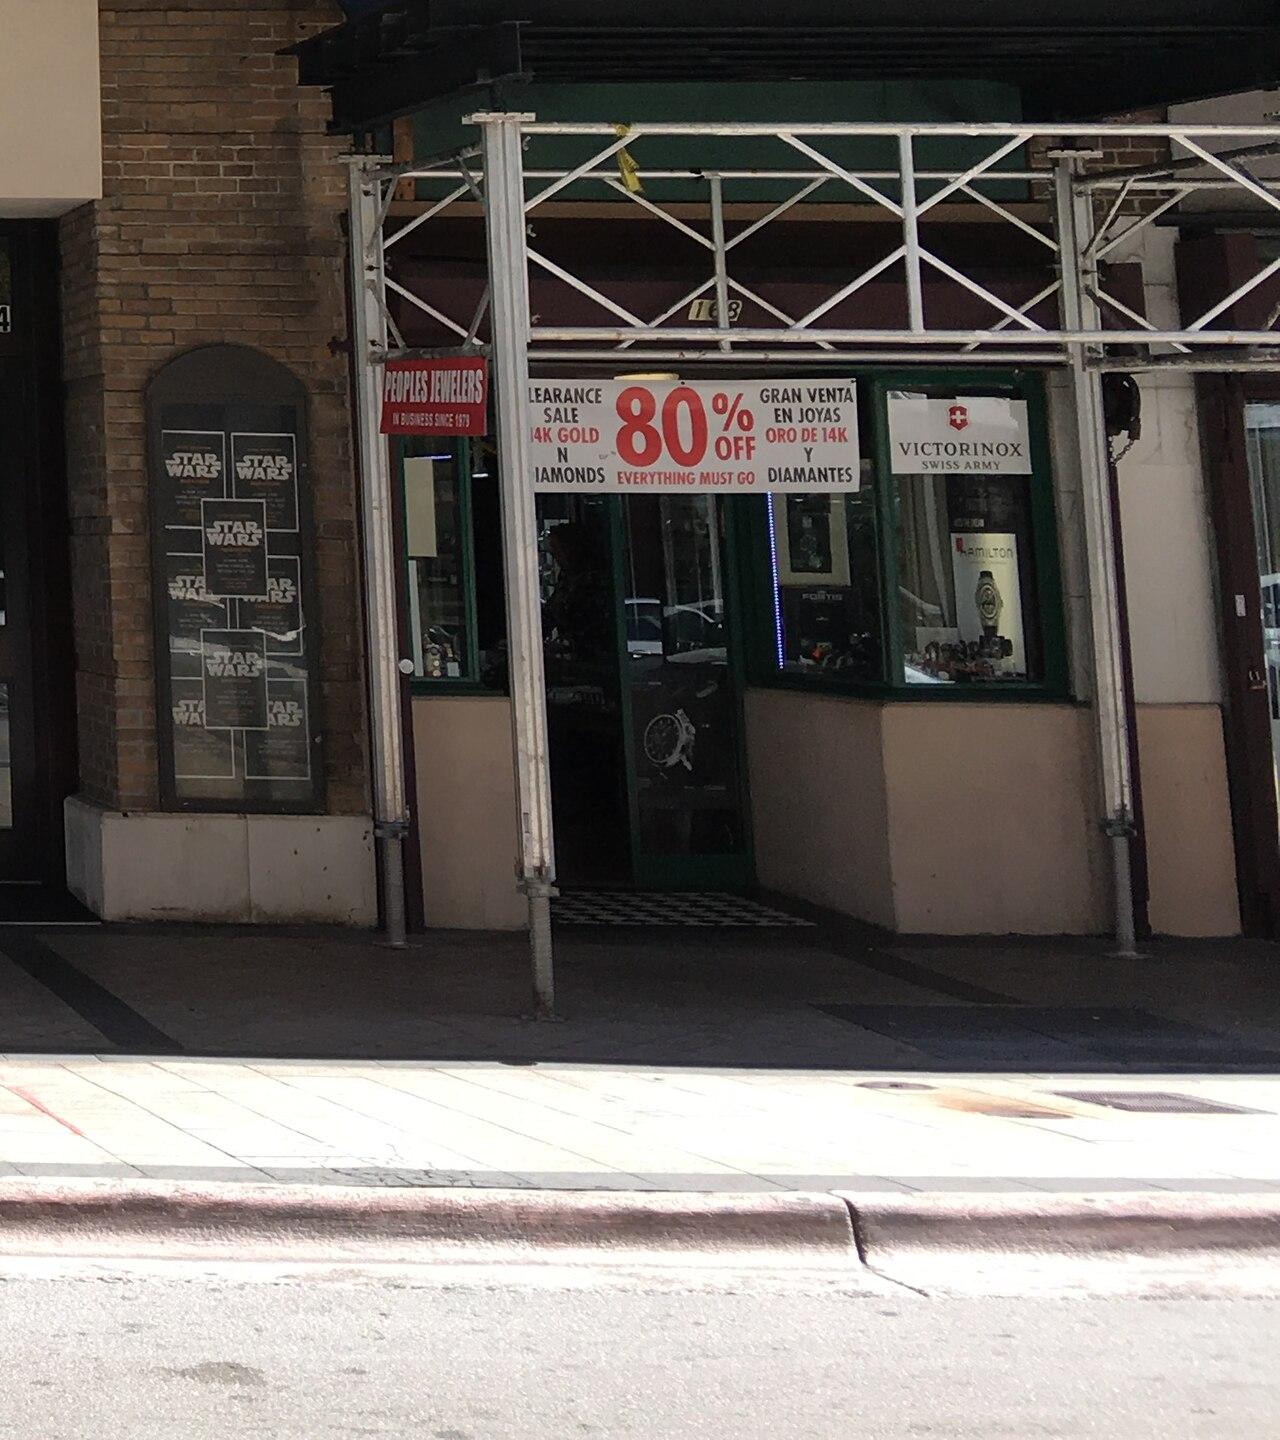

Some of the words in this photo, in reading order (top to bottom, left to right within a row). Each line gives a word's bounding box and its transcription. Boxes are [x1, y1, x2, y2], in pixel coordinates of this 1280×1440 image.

[384, 370, 428, 404] PEOPLES
[430, 368, 484, 404] JEWELERS
[528, 387, 602, 404] LEARANCE
[759, 387, 802, 404] GRAN
[806, 387, 854, 404] VENTA
[392, 412, 400, 426] IN
[400, 412, 434, 427] BUSINESS
[434, 413, 454, 428] SINCE
[543, 407, 579, 424] SALE
[774, 407, 793, 424] EN
[798, 407, 841, 424] JOYAS
[557, 426, 600, 444] GOLD
[765, 427, 797, 443] ORO
[801, 427, 818, 443] DE
[822, 427, 848, 443] 14K
[557, 446, 568, 463] N
[714, 435, 756, 461] OFF
[803, 446, 814, 463] Y
[898, 441, 1024, 458] VICTORINOX
[165, 452, 222, 466] STAR
[235, 454, 292, 468] STAR
[922, 460, 960, 470] SWISS
[964, 460, 1001, 471] ARMY
[165, 465, 222, 479] WARS
[236, 467, 293, 481] WARS
[535, 466, 606, 484] IAMONDS
[617, 471, 696, 485] EVERYTHING
[699, 471, 734, 485] MUST
[737, 471, 755, 485] GO
[768, 466, 853, 483] DIAMANTES
[206, 520, 263, 534] STAR
[206, 533, 263, 547] WARS
[168, 575, 206, 588] STA
[267, 577, 297, 590] AR
[206, 651, 263, 665] STAR
[206, 664, 263, 677] WARS
[172, 712, 205, 725] WA
